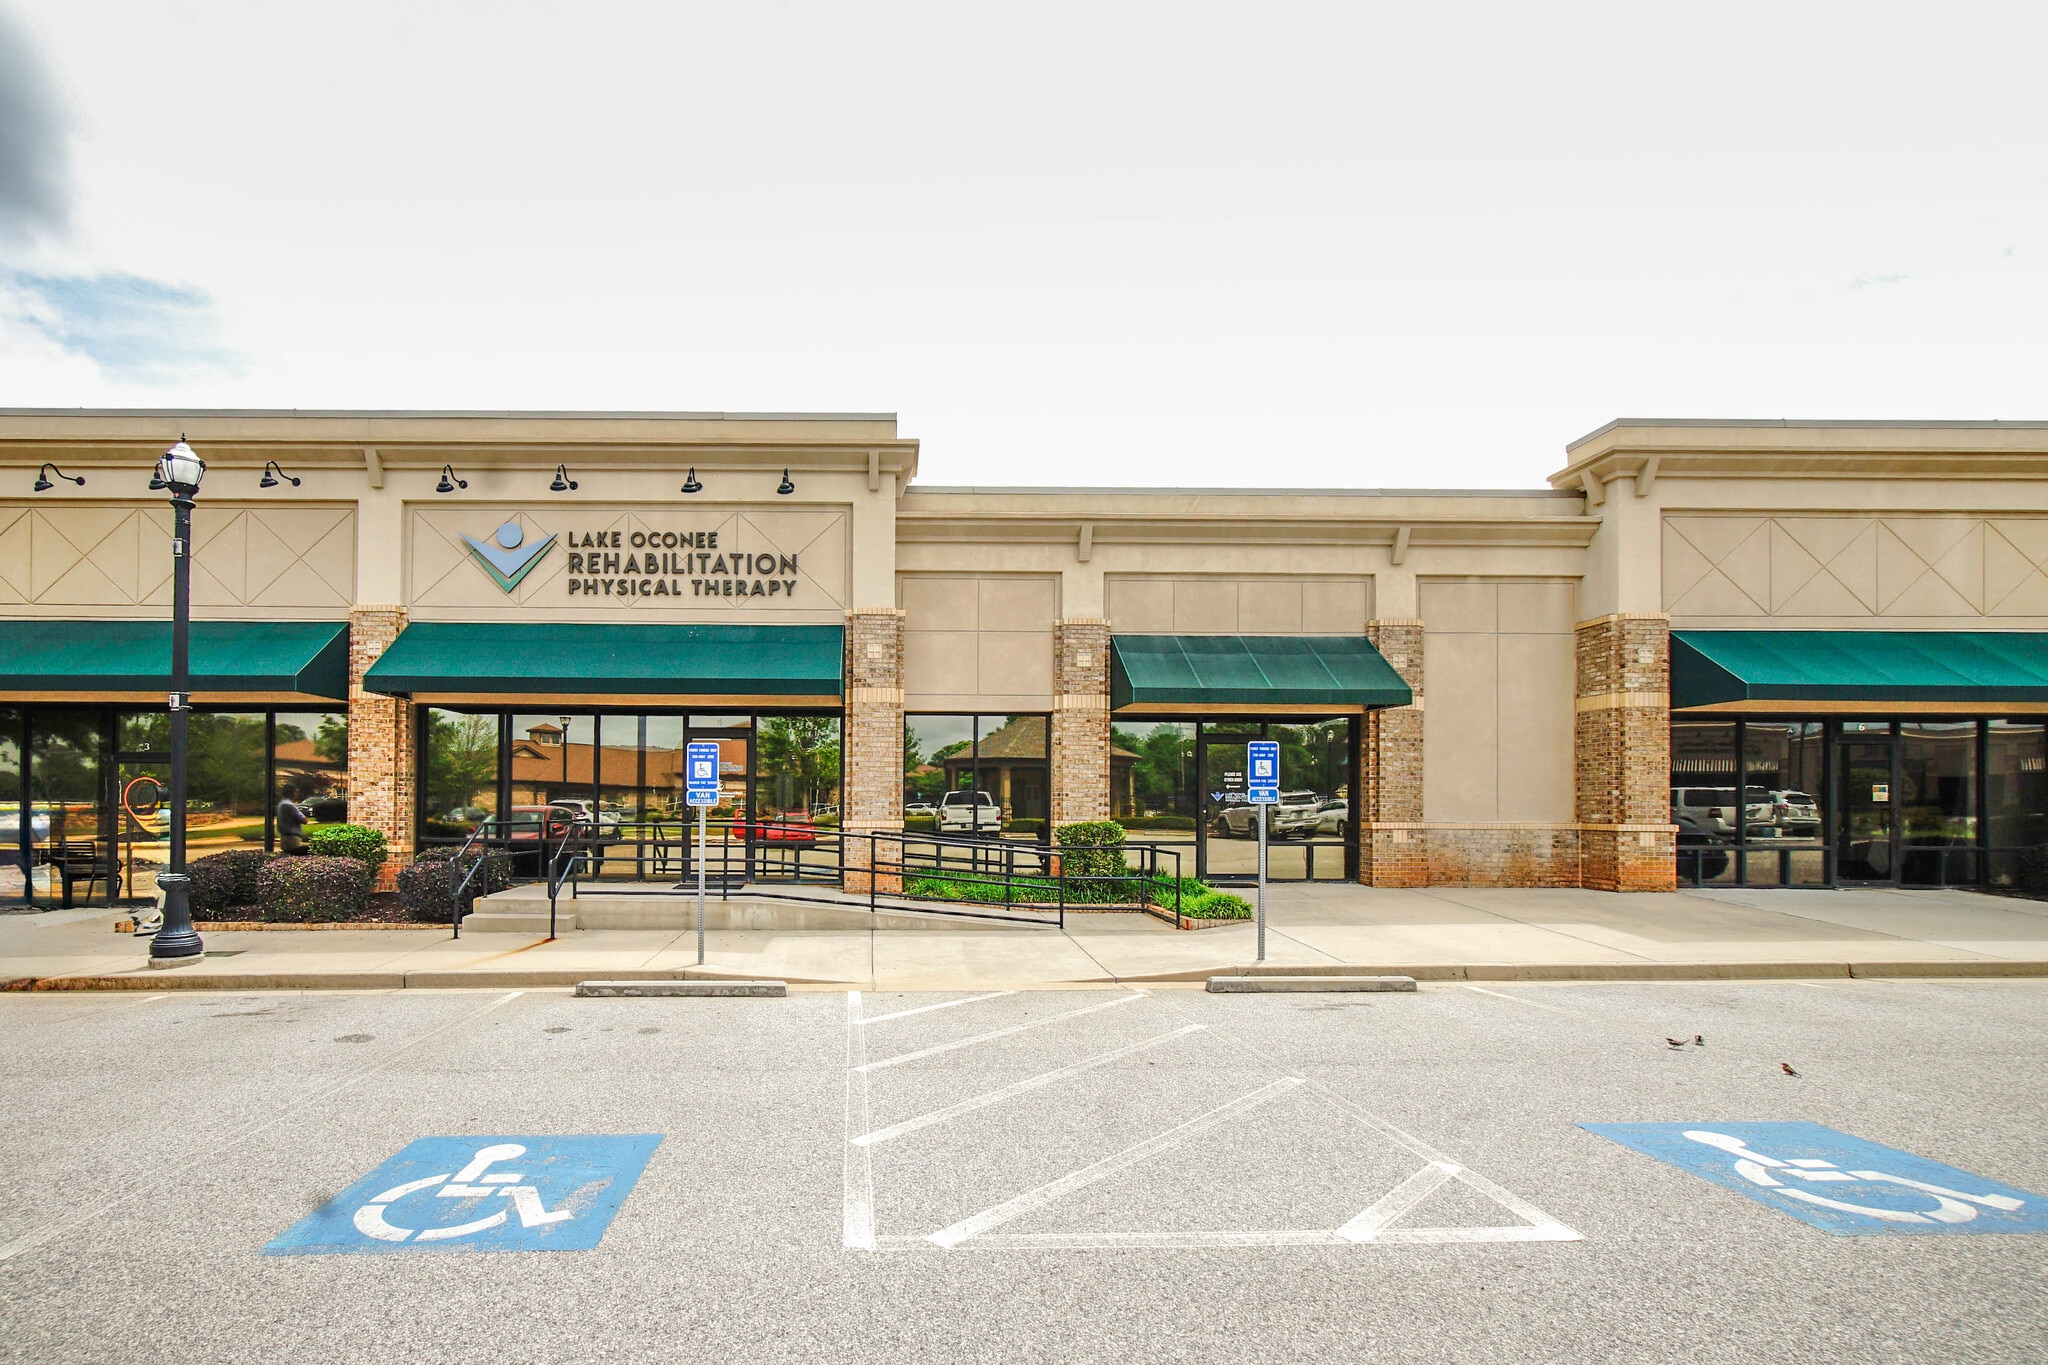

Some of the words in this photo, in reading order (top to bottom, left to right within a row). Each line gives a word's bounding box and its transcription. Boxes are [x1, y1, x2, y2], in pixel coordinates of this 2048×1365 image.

[568, 531, 622, 548] LAKE
[630, 531, 718, 549] OCONEE
[568, 552, 797, 575] REHABILITATION
[568, 578, 682, 596] PHYSICAL
[691, 579, 797, 596] THERAPY
[1858, 722, 1866, 731] 6
[144, 743, 150, 751] 3
